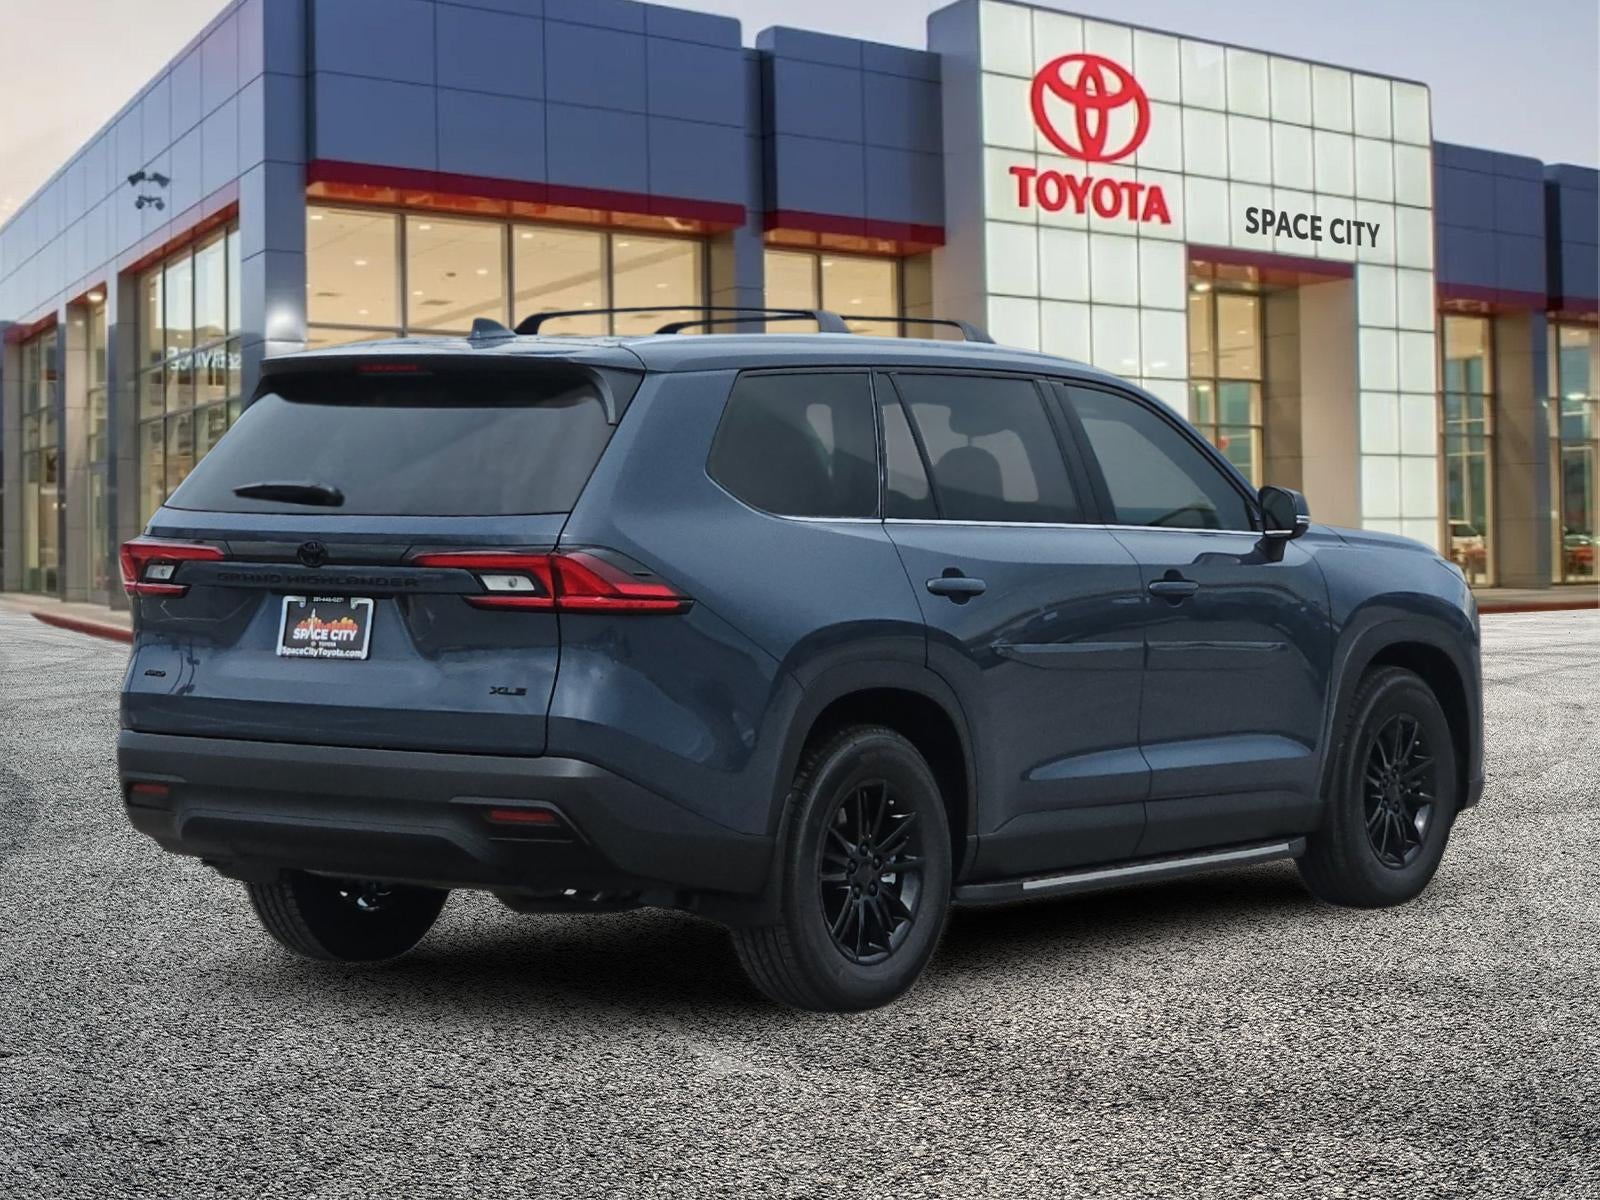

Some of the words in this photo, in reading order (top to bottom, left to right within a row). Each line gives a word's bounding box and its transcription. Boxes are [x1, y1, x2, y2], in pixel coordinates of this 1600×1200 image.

[1009, 167, 1171, 224] TOYOTA
[1245, 207, 1323, 242] SPACE
[1330, 217, 1381, 248] CITY
[217, 572, 282, 584] GRAND
[287, 574, 418, 587] HIGHLANDER
[293, 628, 327, 640] SPACE
[330, 630, 358, 641] CITY
[282, 646, 362, 657] SpaceCityToyota.com
[489, 686, 526, 696] XLE
